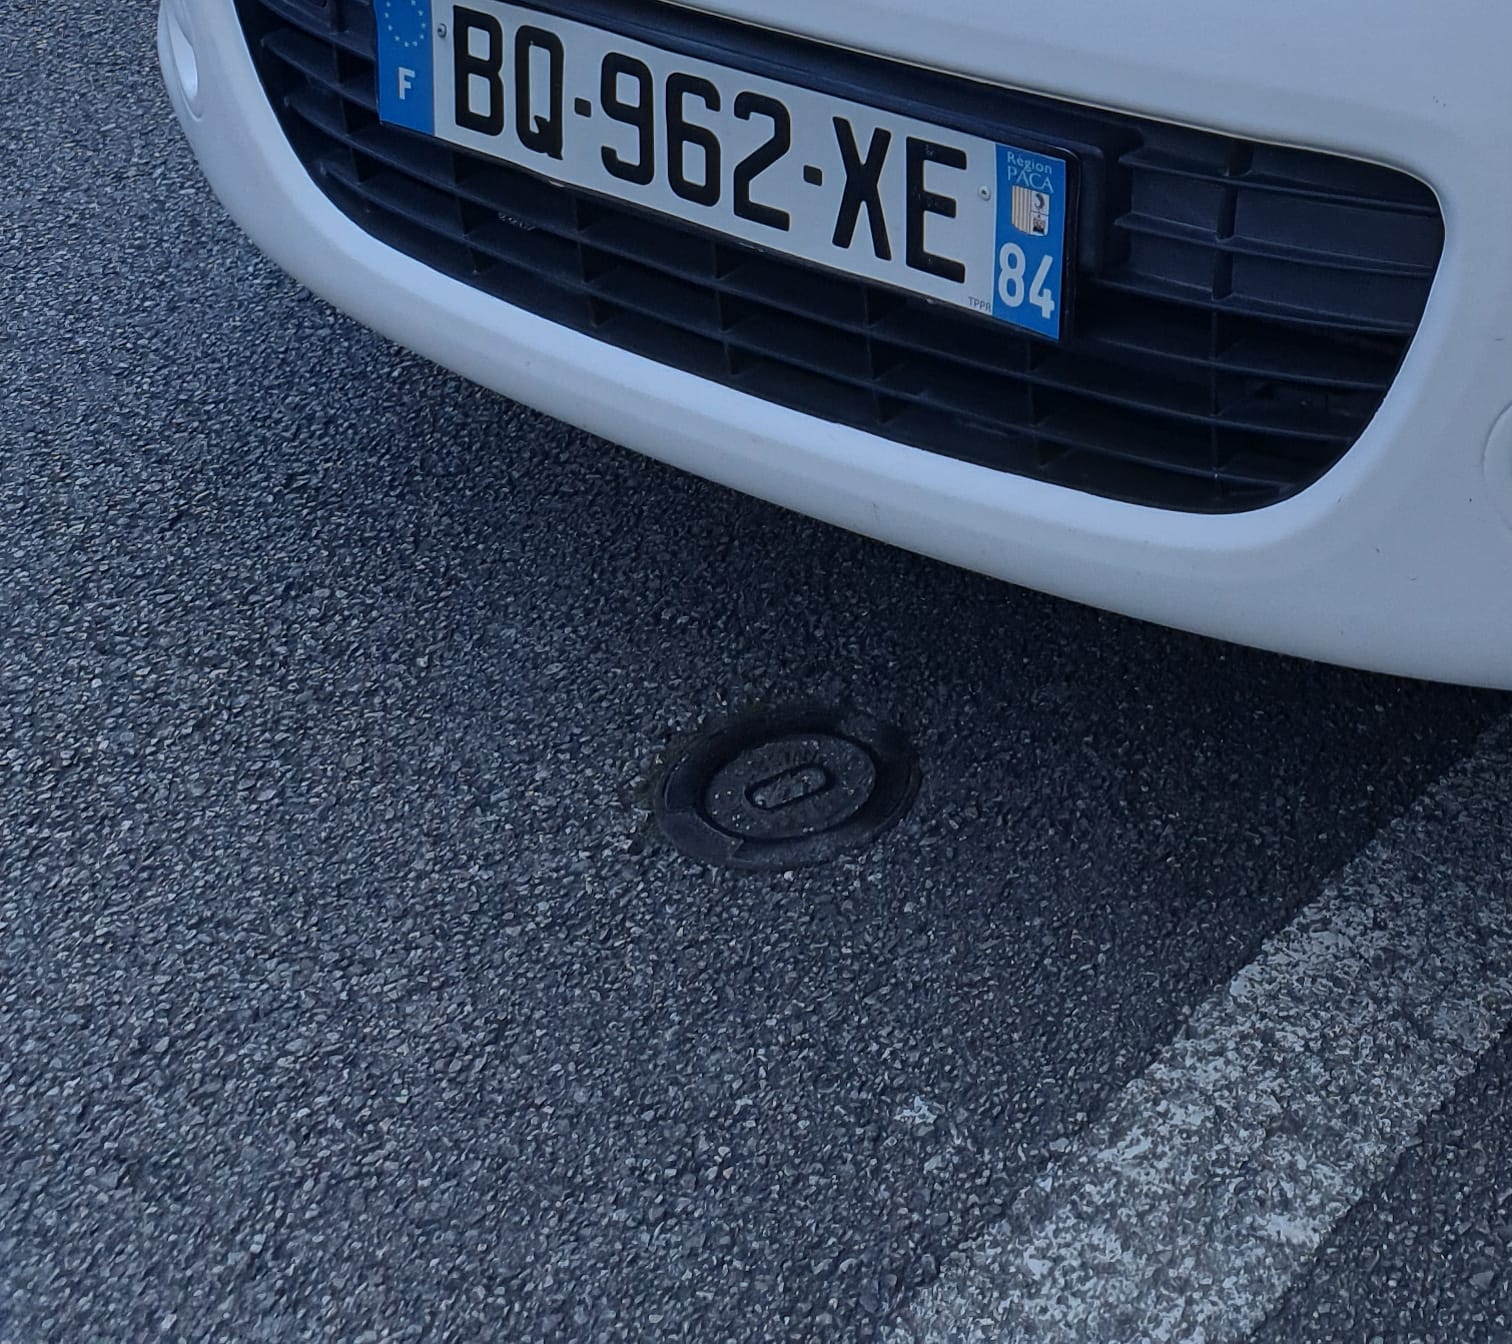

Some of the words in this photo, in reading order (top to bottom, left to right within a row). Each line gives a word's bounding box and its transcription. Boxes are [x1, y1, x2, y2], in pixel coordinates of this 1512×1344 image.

[398, 67, 416, 100] F
[453, 5, 966, 284] BQ-962-XE
[1007, 151, 1052, 174] Région
[1007, 166, 1054, 193] PACA
[998, 242, 1055, 319] 84
